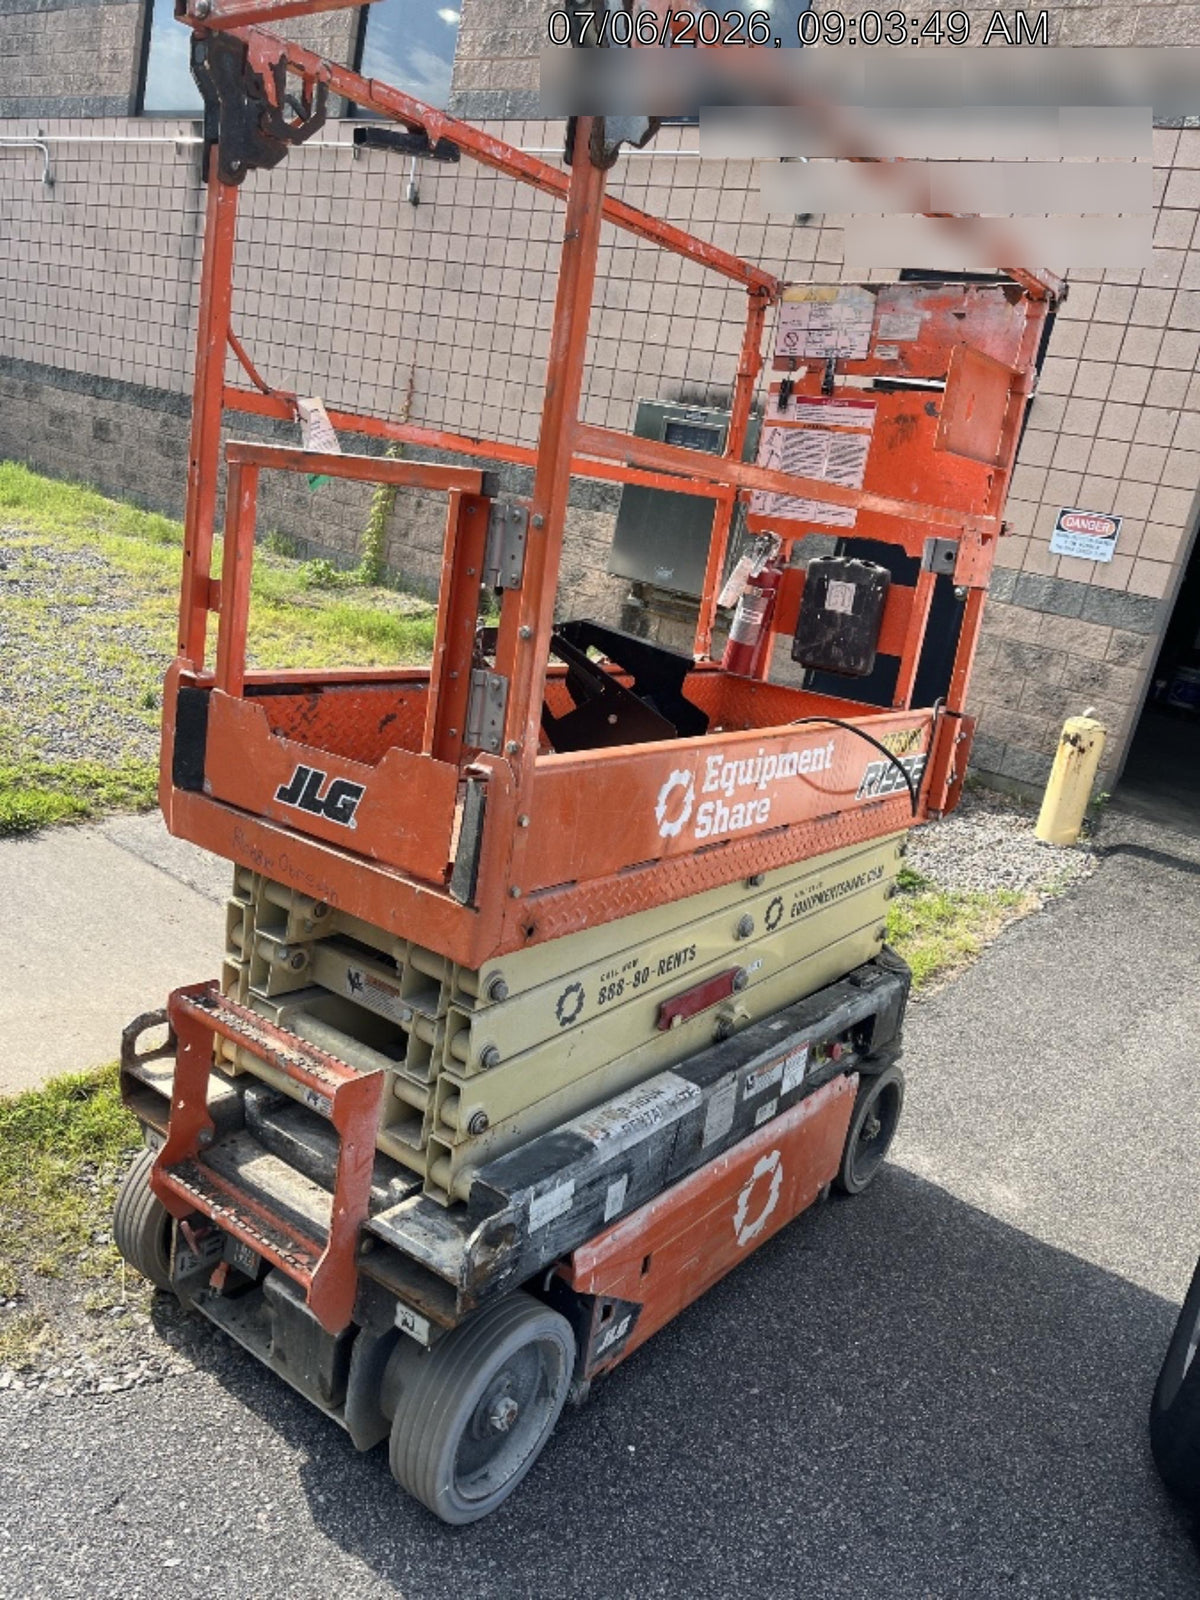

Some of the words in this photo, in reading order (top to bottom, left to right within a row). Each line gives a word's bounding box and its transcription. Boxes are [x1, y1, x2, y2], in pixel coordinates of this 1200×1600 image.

[1066, 516, 1111, 534] DANGER
[273, 763, 367, 828] JLG
[702, 740, 835, 797] Equipment
[694, 795, 771, 838] Share
[597, 944, 697, 1005] 888-80-RENTS
